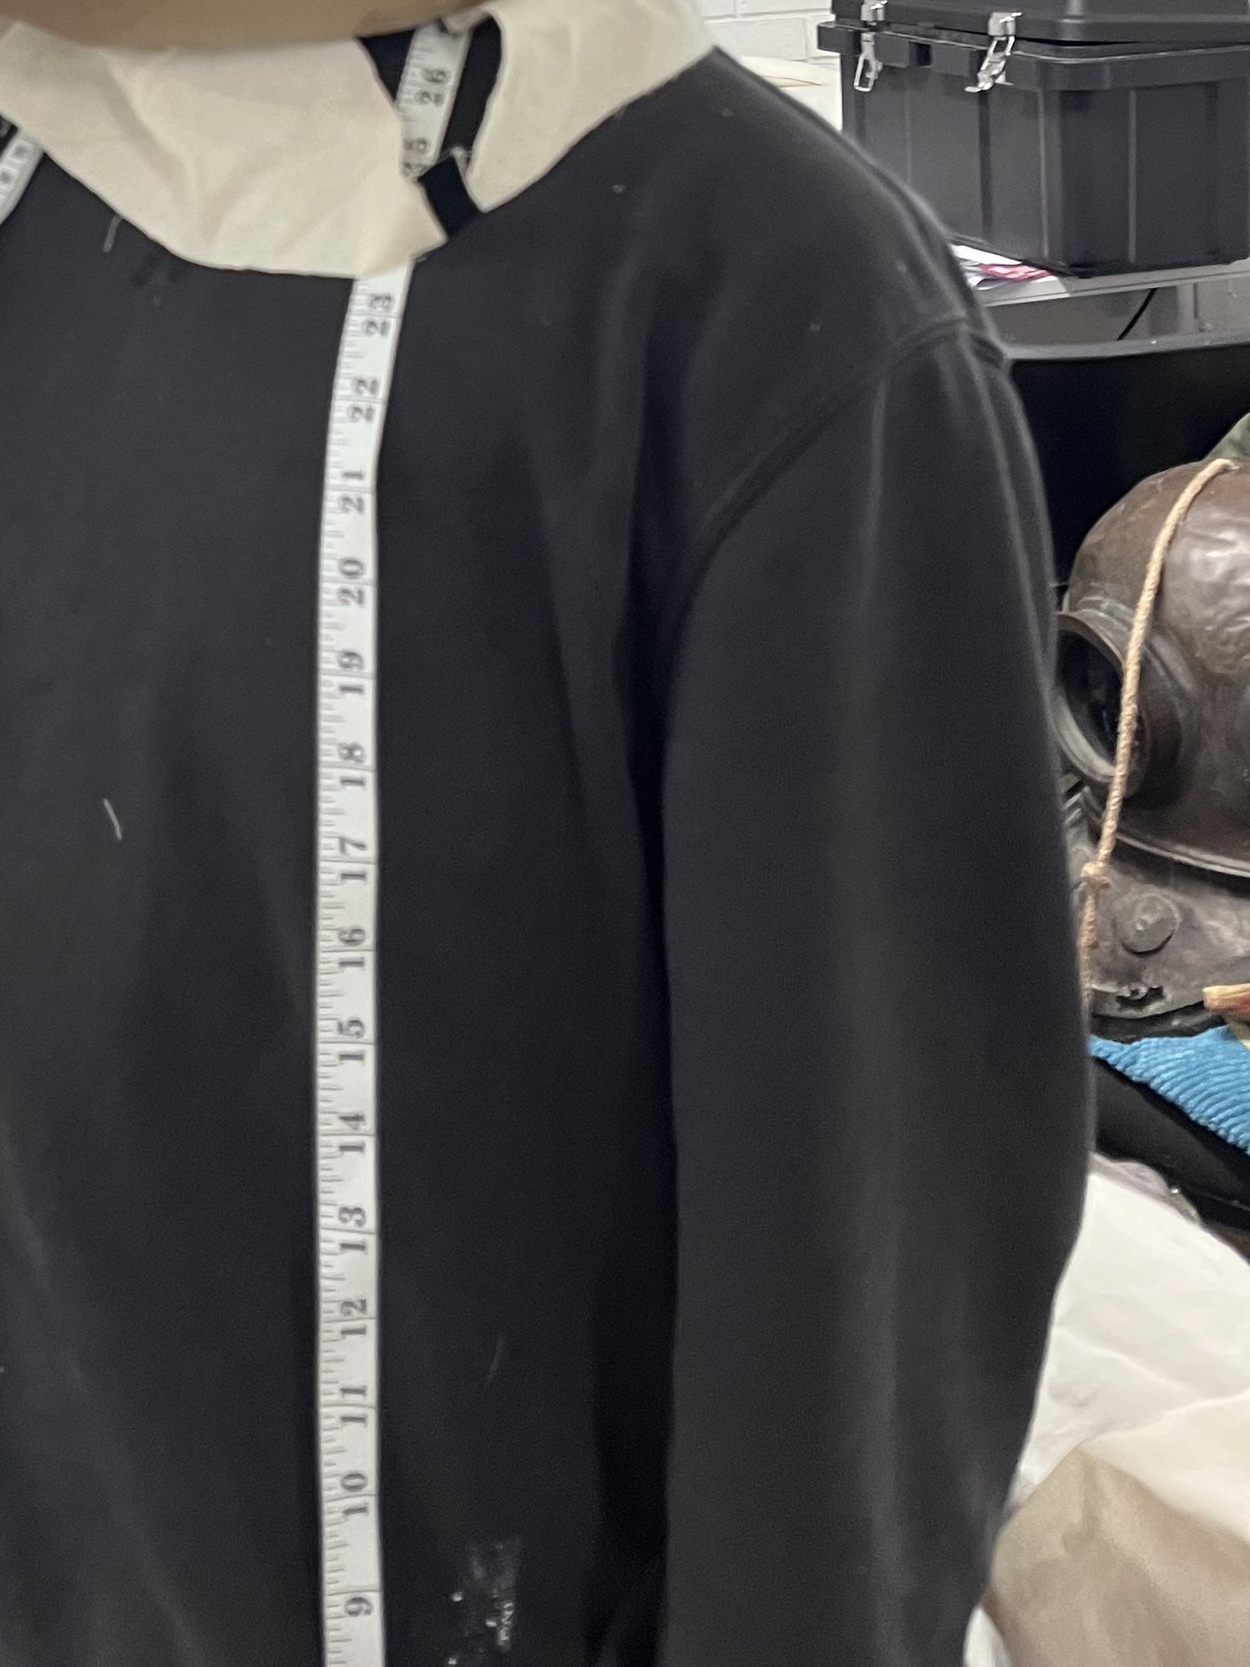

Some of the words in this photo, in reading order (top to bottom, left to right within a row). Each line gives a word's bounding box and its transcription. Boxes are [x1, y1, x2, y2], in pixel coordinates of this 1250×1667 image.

[414, 67, 447, 105] 26
[364, 292, 395, 337] 23
[346, 376, 379, 422] 22
[338, 468, 366, 514] 21
[337, 559, 365, 607] 20
[337, 648, 365, 697] 19
[337, 741, 367, 790] 18
[337, 836, 367, 884] 17
[337, 926, 366, 971] 16
[337, 1018, 365, 1065] 15
[338, 1113, 367, 1156] 14
[338, 1205, 368, 1254] 13
[339, 1298, 368, 1339] 12
[339, 1383, 368, 1428] 11
[339, 1471, 369, 1520] 10
